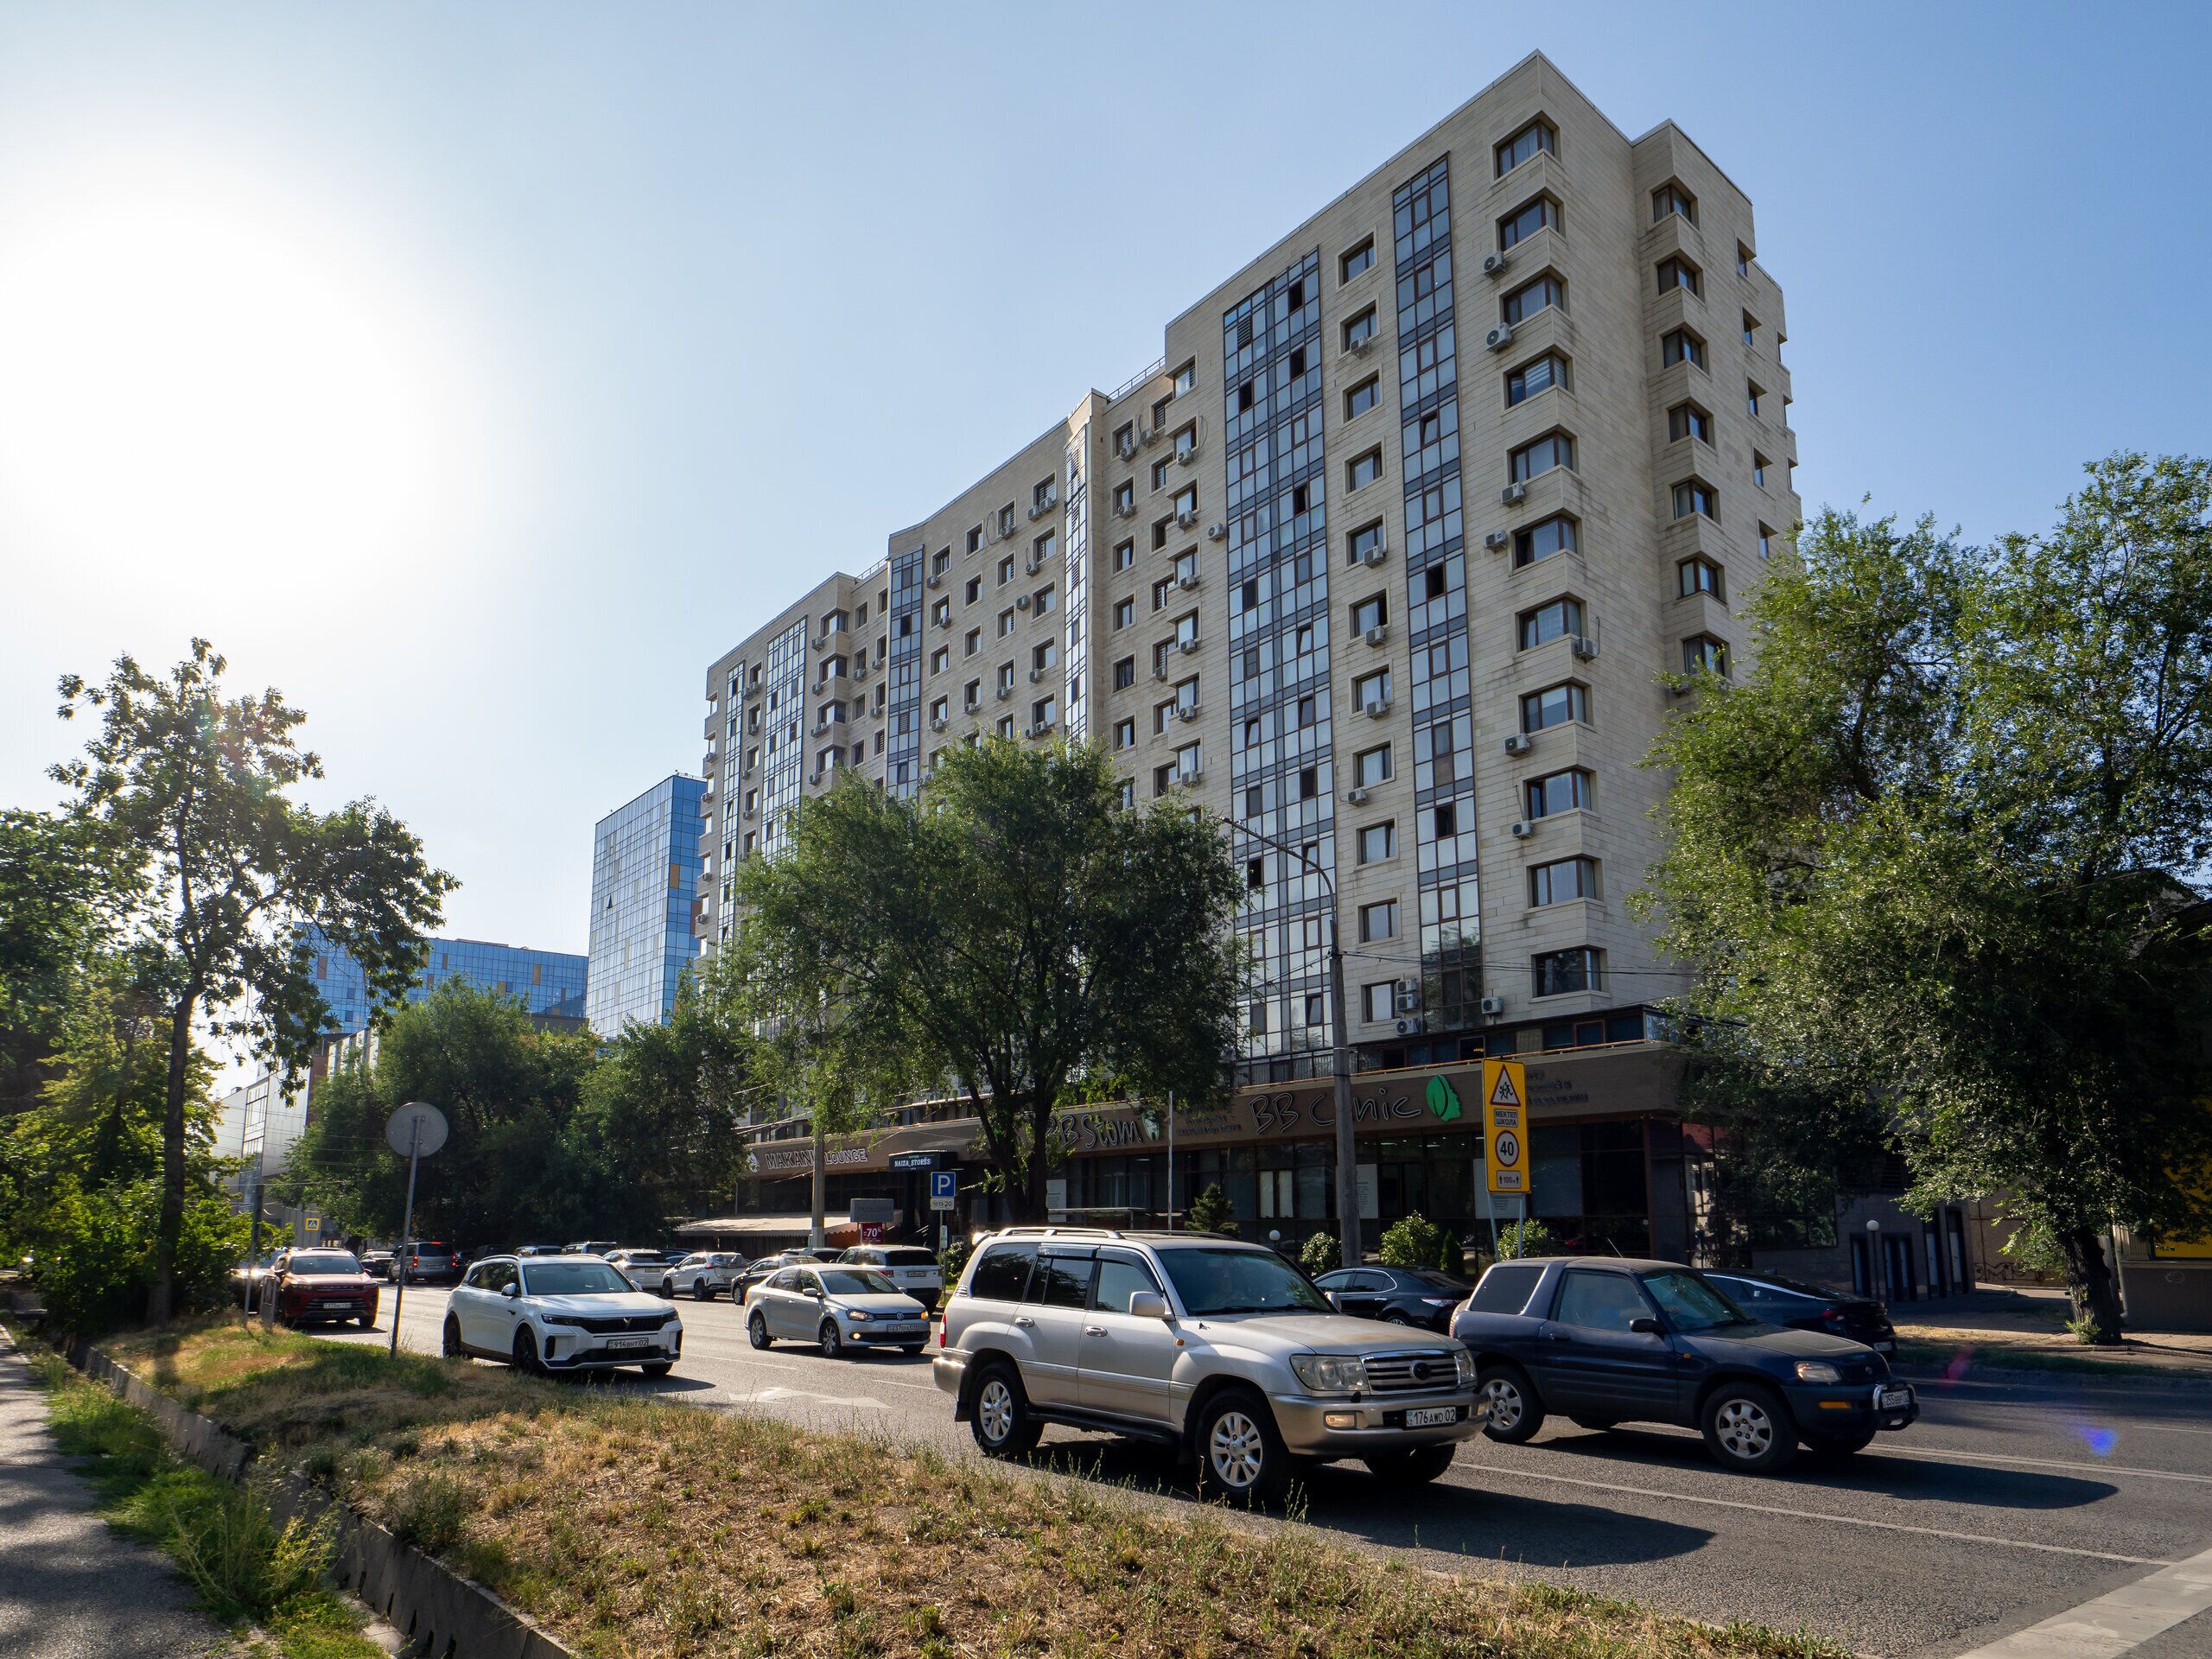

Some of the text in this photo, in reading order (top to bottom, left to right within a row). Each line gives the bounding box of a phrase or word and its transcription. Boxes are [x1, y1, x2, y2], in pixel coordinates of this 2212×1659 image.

[1249, 1086, 1422, 1135] BB Cnic
[1495, 1110, 1517, 1119] МЕКТЕП
[1080, 1113, 1142, 1149] Stom
[824, 1147, 868, 1166] LOUNGE
[1499, 1141, 1515, 1156] 40
[938, 1174, 950, 1195] P
[1445, 1408, 1455, 1422] 02
